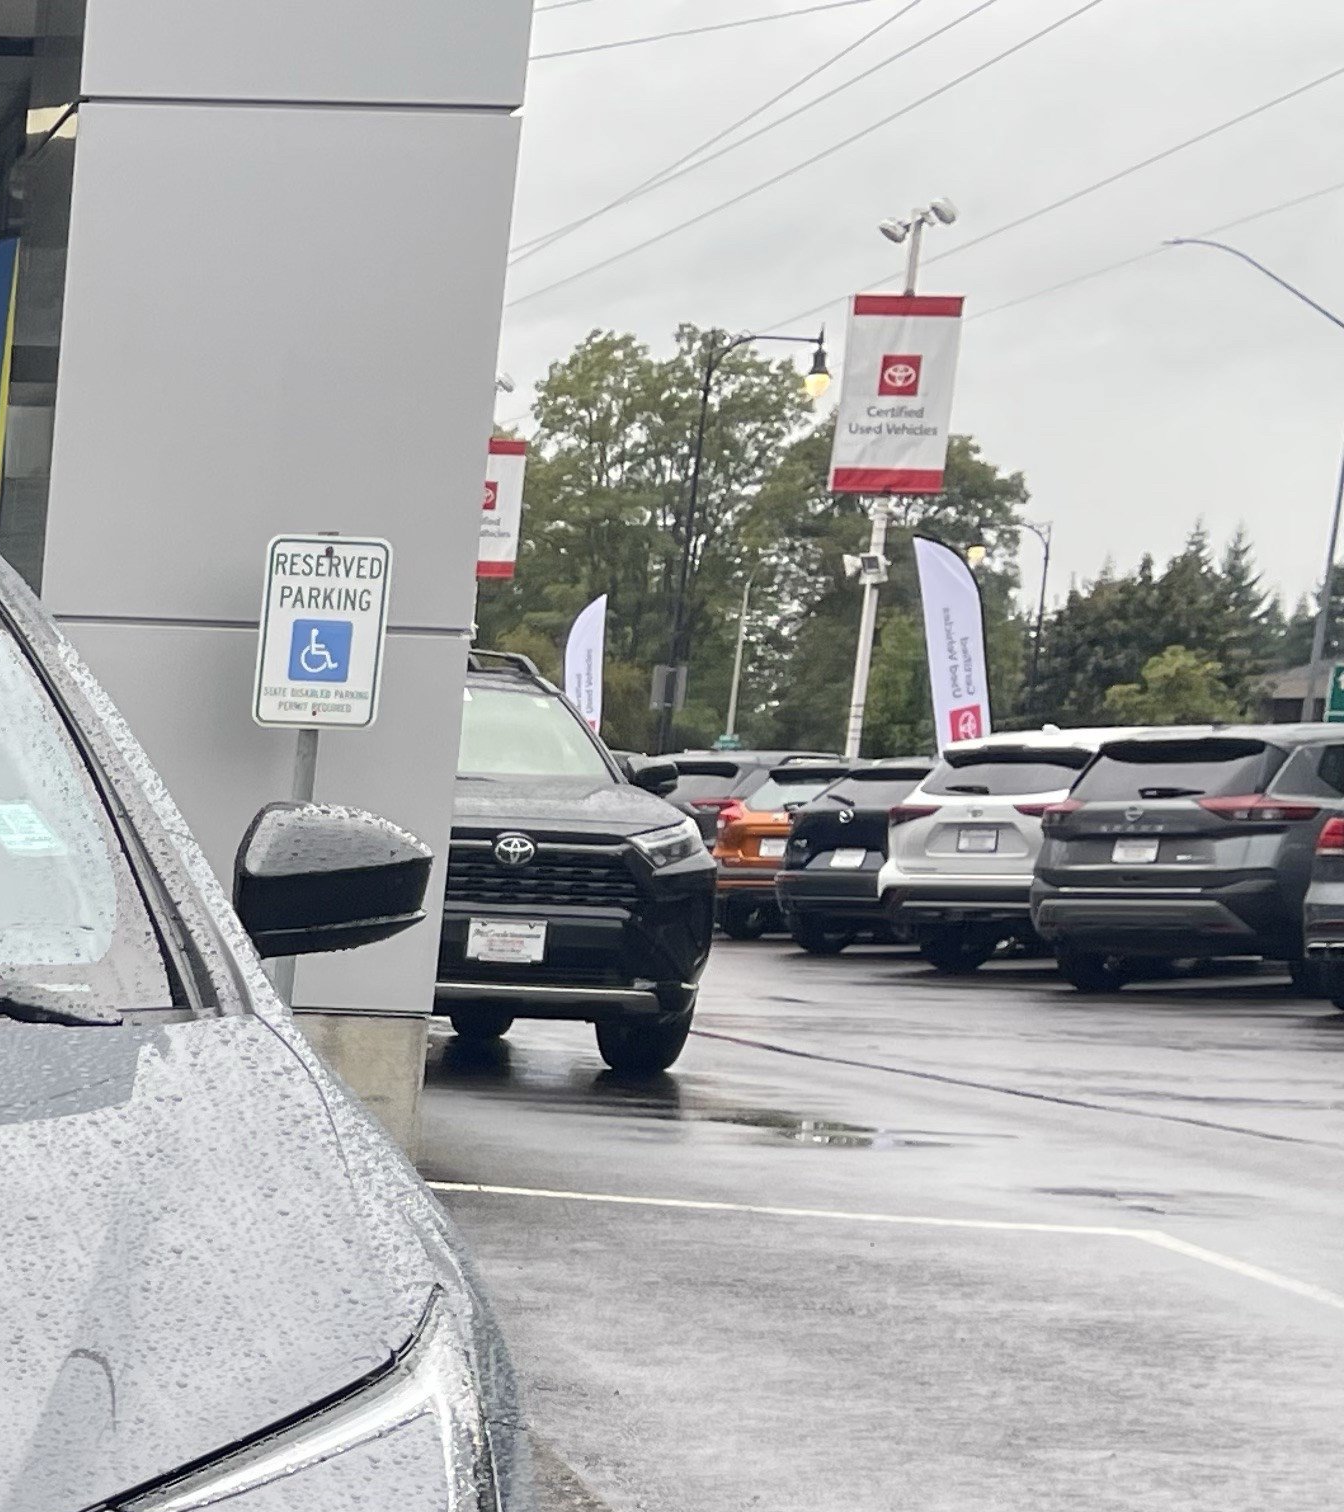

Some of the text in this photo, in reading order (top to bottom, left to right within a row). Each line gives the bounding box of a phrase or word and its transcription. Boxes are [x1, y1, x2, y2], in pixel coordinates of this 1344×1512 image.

[867, 405, 925, 419] Certified
[848, 422, 938, 436] Used Vehicles
[274, 553, 383, 579] RESERVED
[279, 585, 372, 612] PARKING
